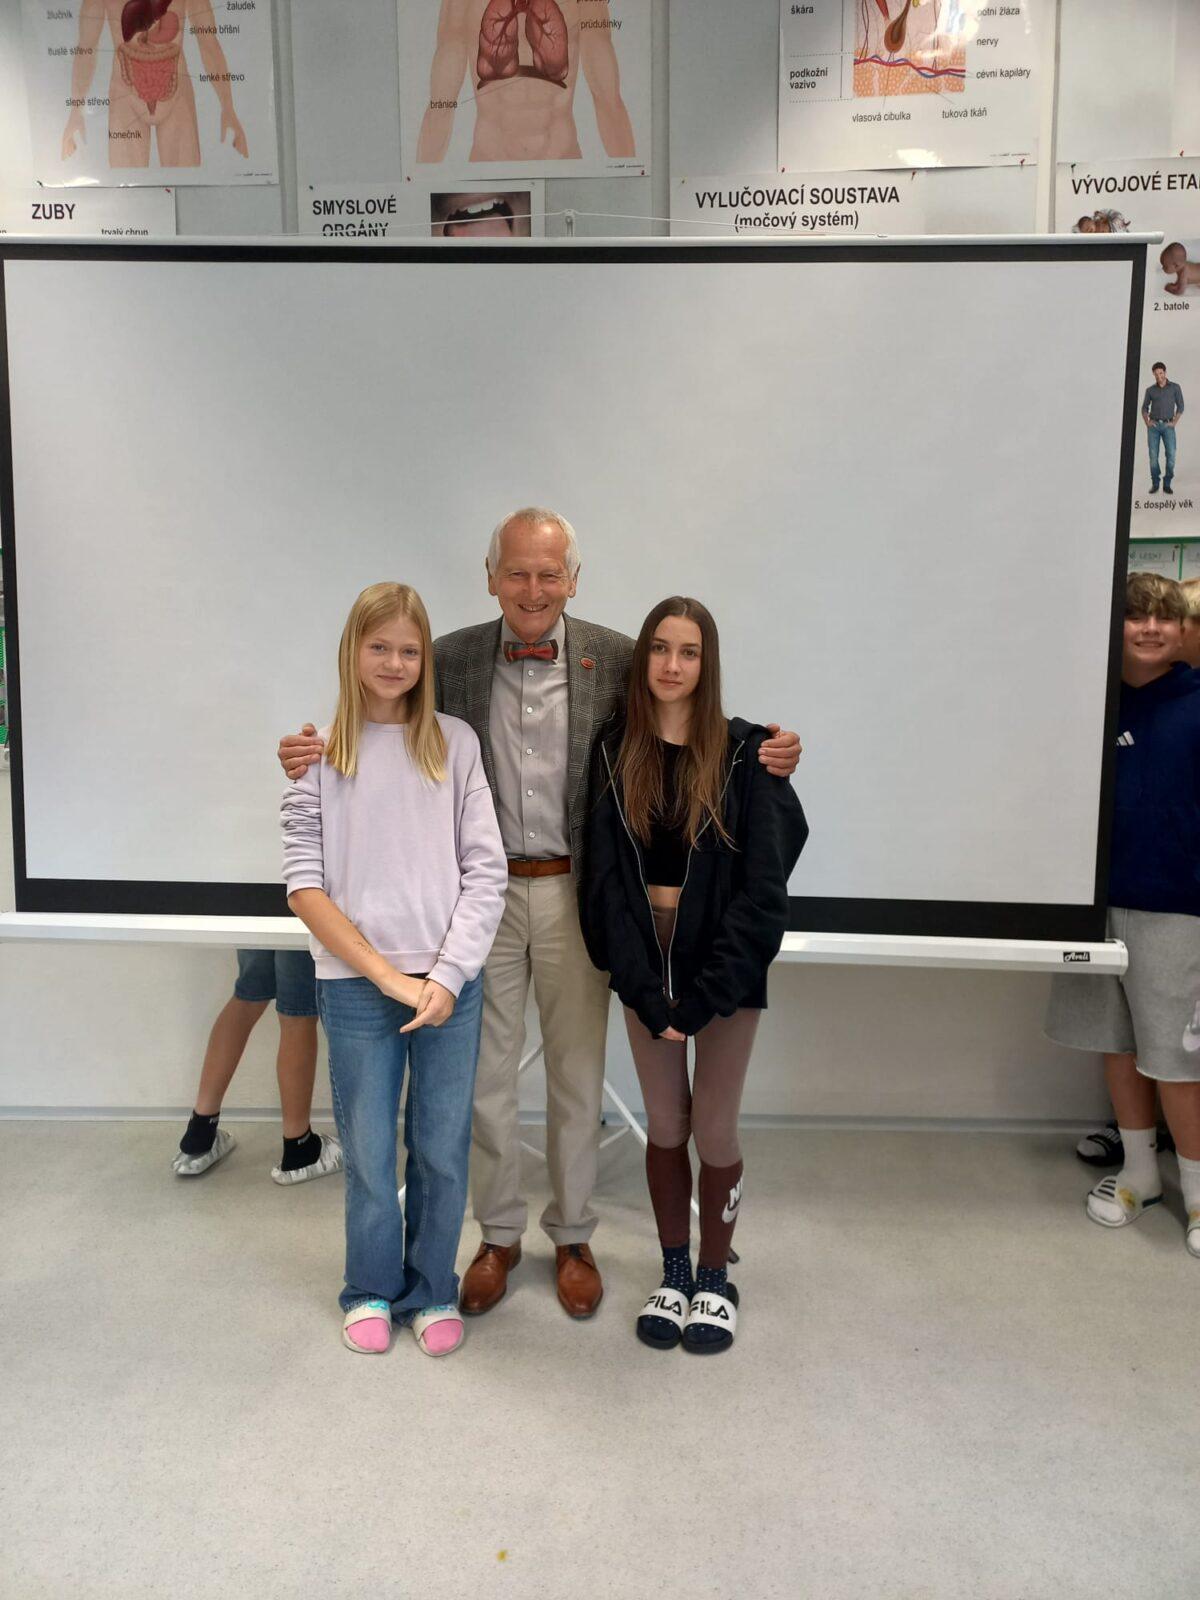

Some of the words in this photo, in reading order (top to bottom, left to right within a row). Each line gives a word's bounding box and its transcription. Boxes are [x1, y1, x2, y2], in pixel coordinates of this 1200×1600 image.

[227, 1, 256, 10] žaludek
[791, 5, 814, 14] škára
[977, 38, 999, 47] nervy
[790, 67, 828, 79] podkožní
[790, 80, 816, 89] vazivo
[852, 112, 882, 122] vlasová
[942, 109, 968, 119] tuková
[1072, 171, 1162, 195] VÝVOJOVÉ
[695, 184, 805, 209] VYLUČOVACÍ
[809, 186, 900, 205] SOUSTAVA
[312, 194, 397, 216] SMYSLOVÉ
[31, 203, 76, 220] ZUBY
[734, 211, 797, 232] (močový
[801, 211, 859, 230] systém)
[322, 219, 389, 237] ORGÁNY
[1154, 302, 1161, 311] 2.
[1163, 301, 1190, 311] batole
[1134, 501, 1142, 509] 5.
[1143, 500, 1176, 511] dospělý
[1178, 500, 1193, 508] věk
[644, 1295, 682, 1317] FILA
[690, 1300, 730, 1321] FILA
